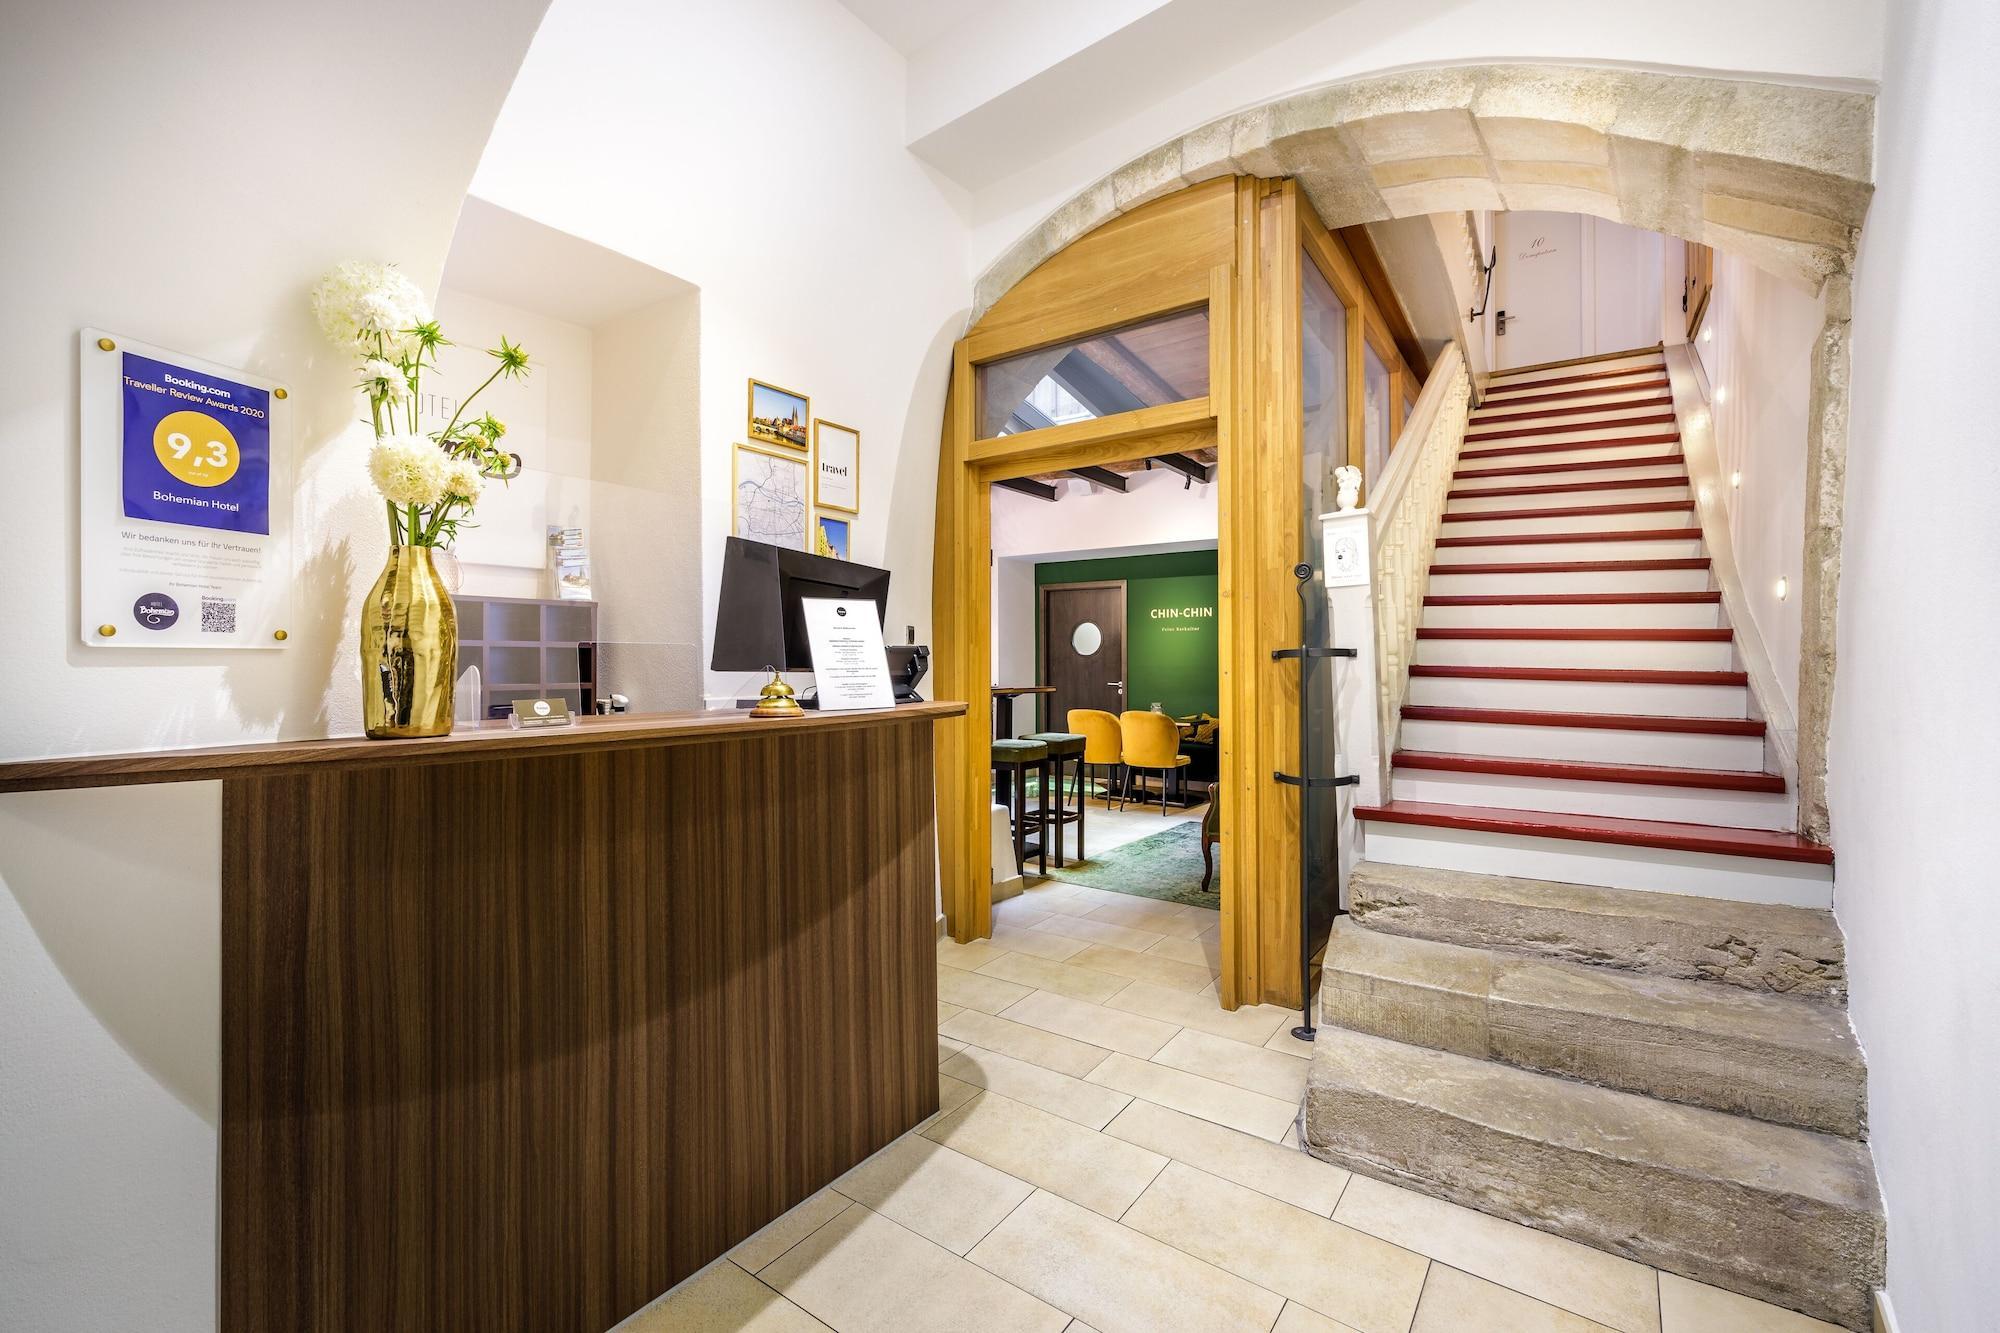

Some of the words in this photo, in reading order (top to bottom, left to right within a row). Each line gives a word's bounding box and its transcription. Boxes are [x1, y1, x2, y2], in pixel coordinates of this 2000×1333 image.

[123, 375, 167, 395] Traveller
[169, 387, 204, 404] Review
[205, 397, 239, 413] Awards
[240, 405, 265, 419] 2020
[164, 373, 231, 399] Booking.com
[167, 432, 228, 468] 9,3
[153, 490, 209, 508] Bohemian
[211, 499, 240, 512] Hotel
[121, 531, 136, 539] Wir
[138, 533, 179, 544] bedanken
[198, 540, 210, 548] für
[223, 543, 261, 553] Vertrauen!
[1150, 606, 1213, 619] CHIN-CHIN
